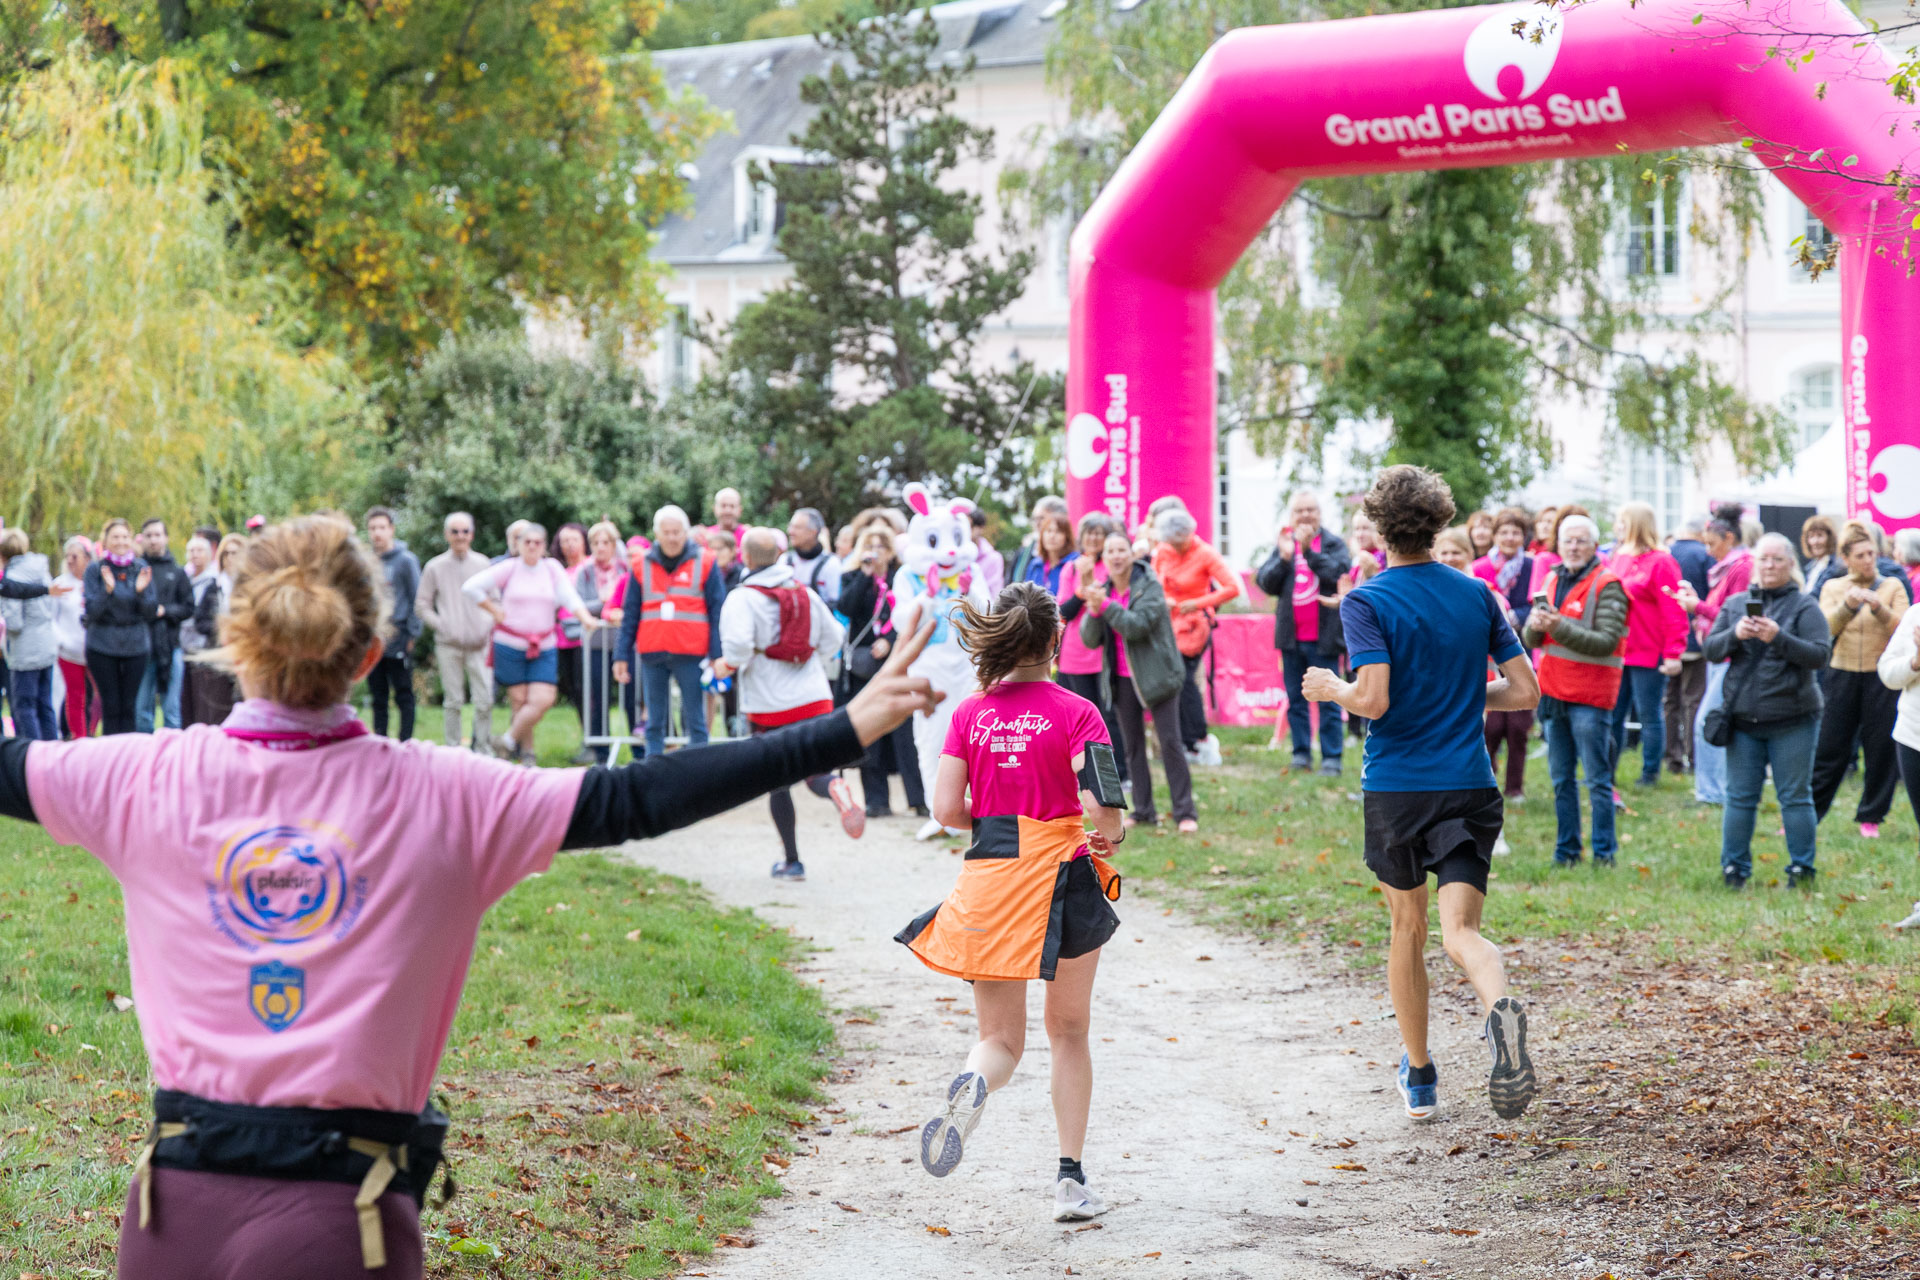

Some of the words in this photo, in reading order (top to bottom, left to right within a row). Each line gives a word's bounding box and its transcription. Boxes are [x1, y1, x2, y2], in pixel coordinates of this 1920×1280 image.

[1325, 104, 1443, 146] Grand
[1443, 103, 1545, 137] Paris
[1546, 86, 1626, 127] Sud
[1104, 374, 1127, 424] Sud
[1851, 334, 1871, 425] Grand
[1104, 427, 1127, 494] Paris
[1854, 429, 1871, 504] Paris
[976, 708, 1053, 746] Sénartaise
[257, 871, 314, 892] plaisir
